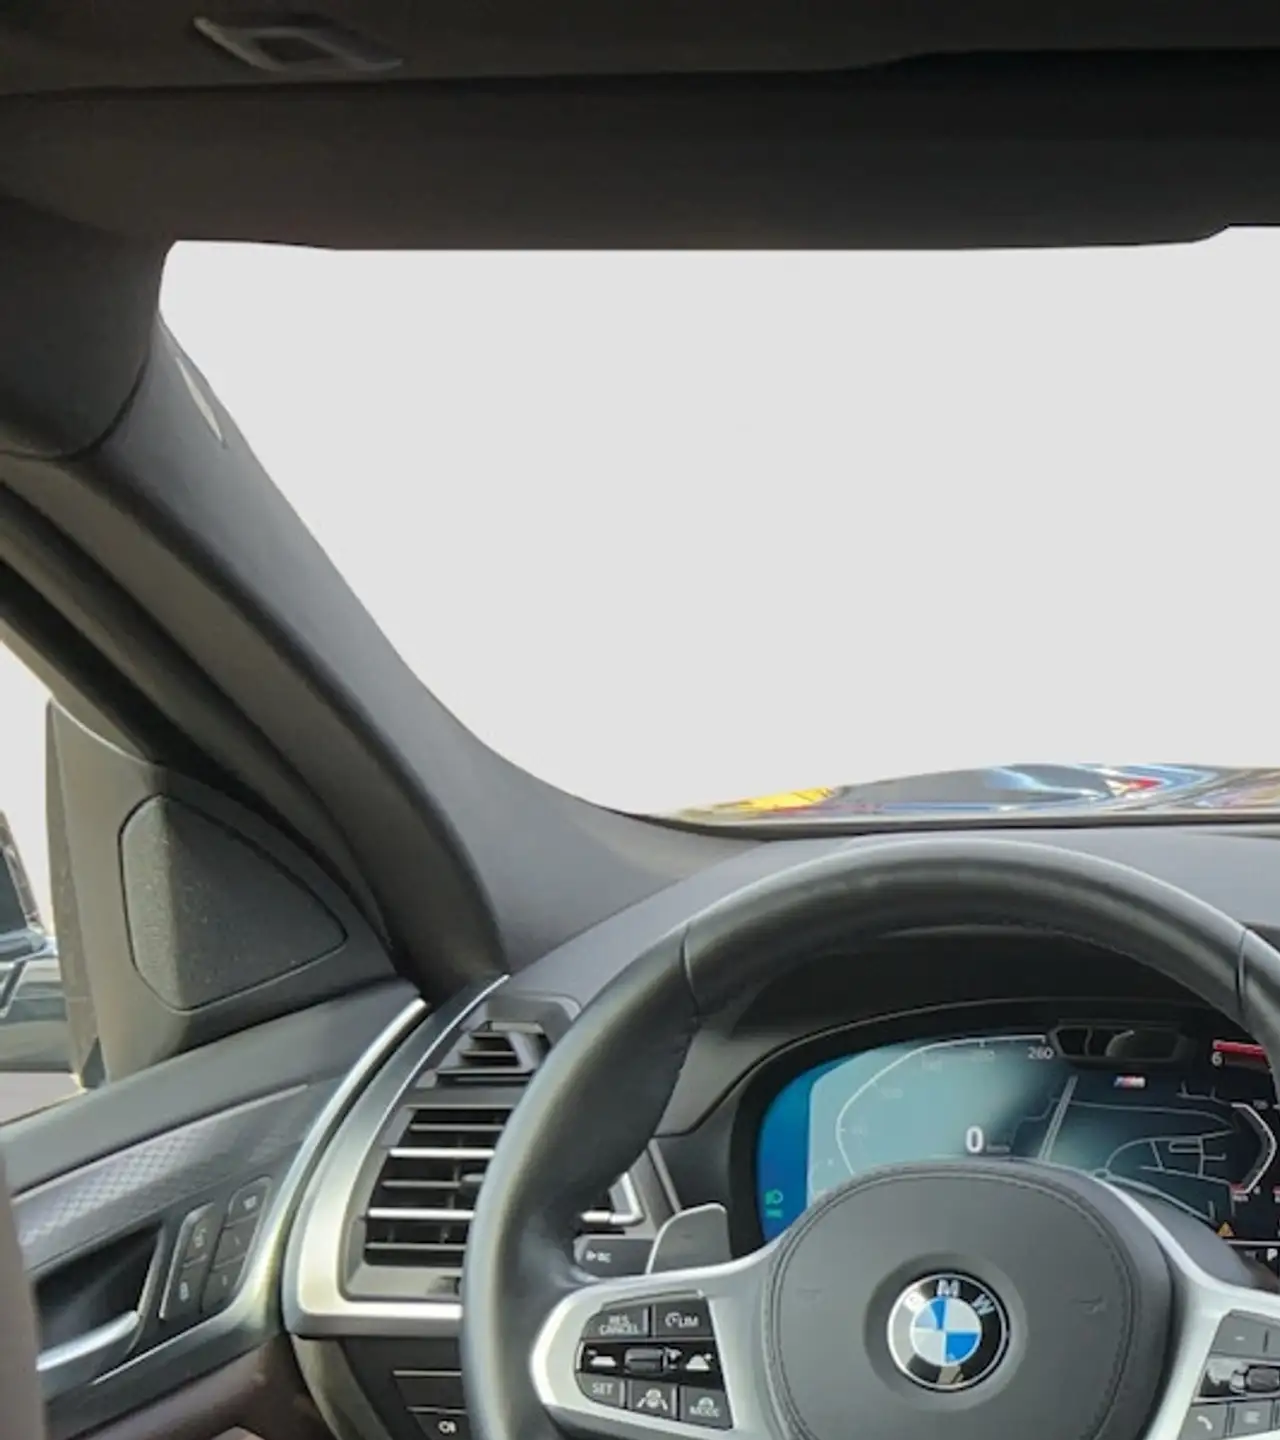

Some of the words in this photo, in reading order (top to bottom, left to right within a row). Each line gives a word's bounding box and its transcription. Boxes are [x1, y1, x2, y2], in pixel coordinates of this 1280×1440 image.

[1027, 1046, 1054, 1060] 260
[1211, 1052, 1222, 1067] 6
[964, 1125, 985, 1154] 0
[903, 1279, 995, 1317] BMW
[600, 1323, 639, 1336] CANCEL
[592, 1382, 613, 1395] SET
